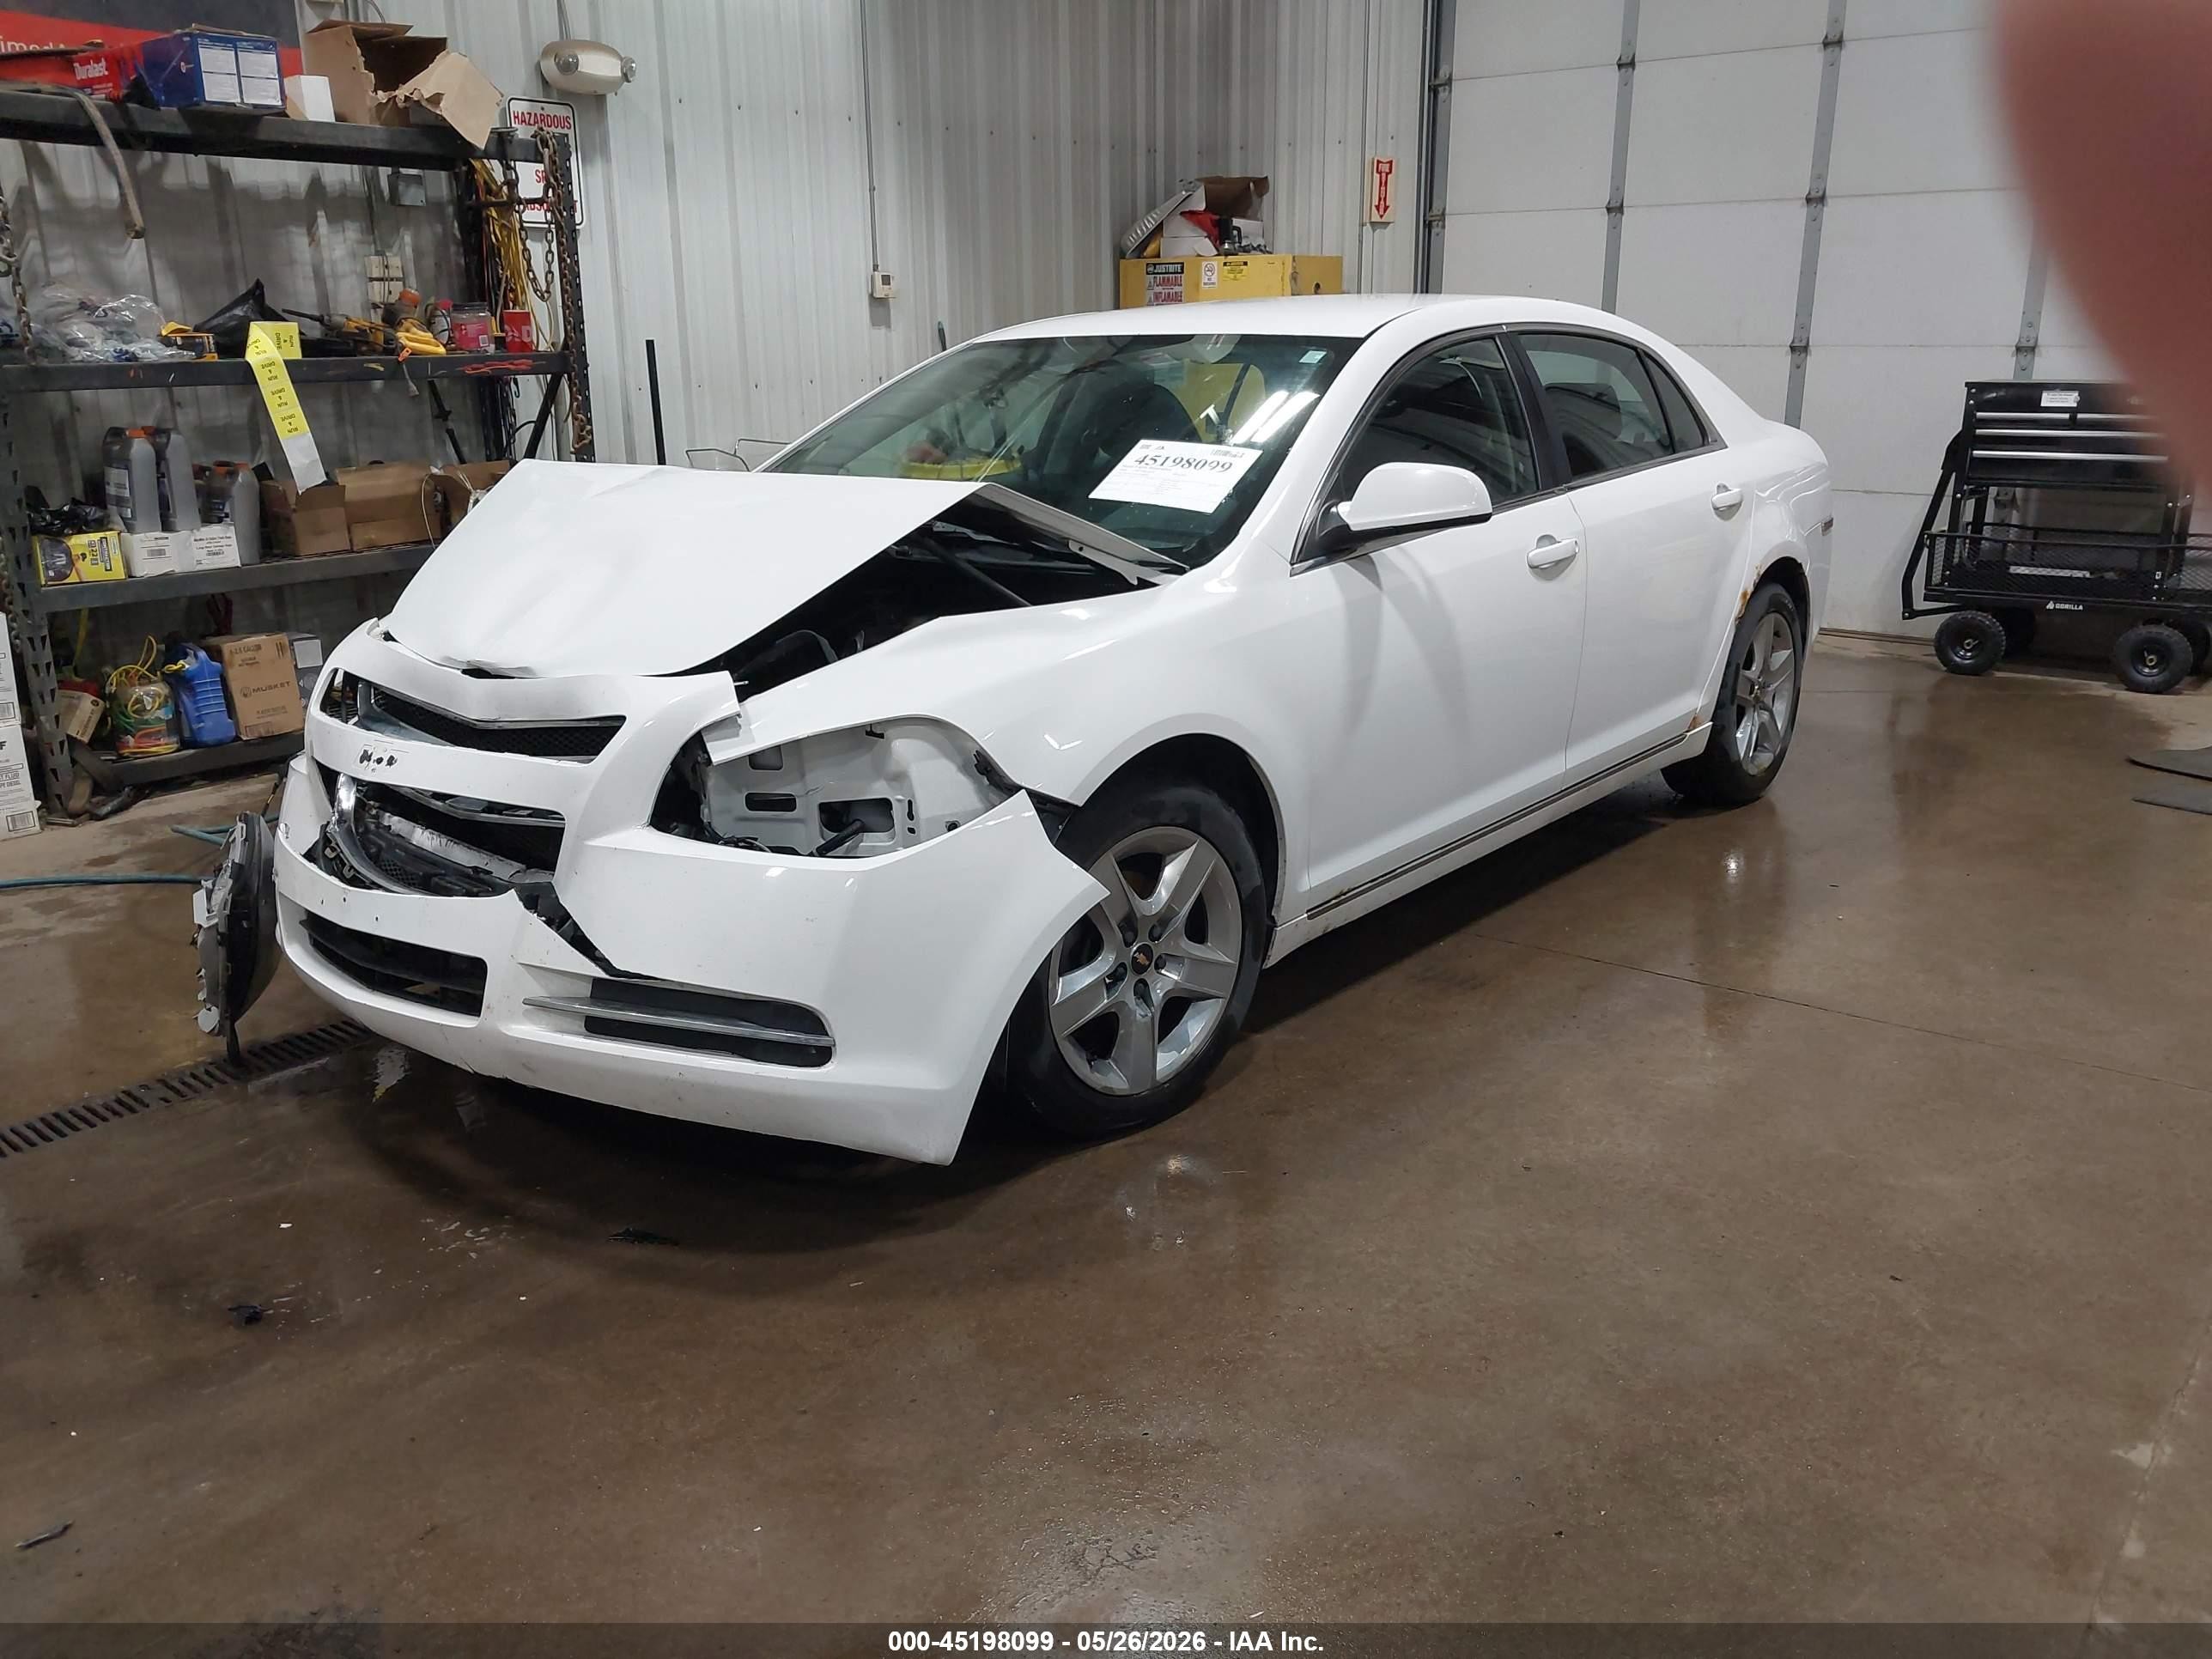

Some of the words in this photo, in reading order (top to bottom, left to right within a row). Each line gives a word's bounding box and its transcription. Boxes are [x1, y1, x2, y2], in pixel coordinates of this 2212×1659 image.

[73, 58, 108, 80] Duralast
[513, 111, 572, 130] HAZARDOUS
[1153, 264, 1182, 273] JUSTRITE
[261, 361, 276, 369] DRIVE
[270, 387, 285, 396] DRIVE
[280, 413, 295, 422] DRIVE
[1134, 453, 1233, 473] 45198099
[252, 681, 291, 694] MUSKET
